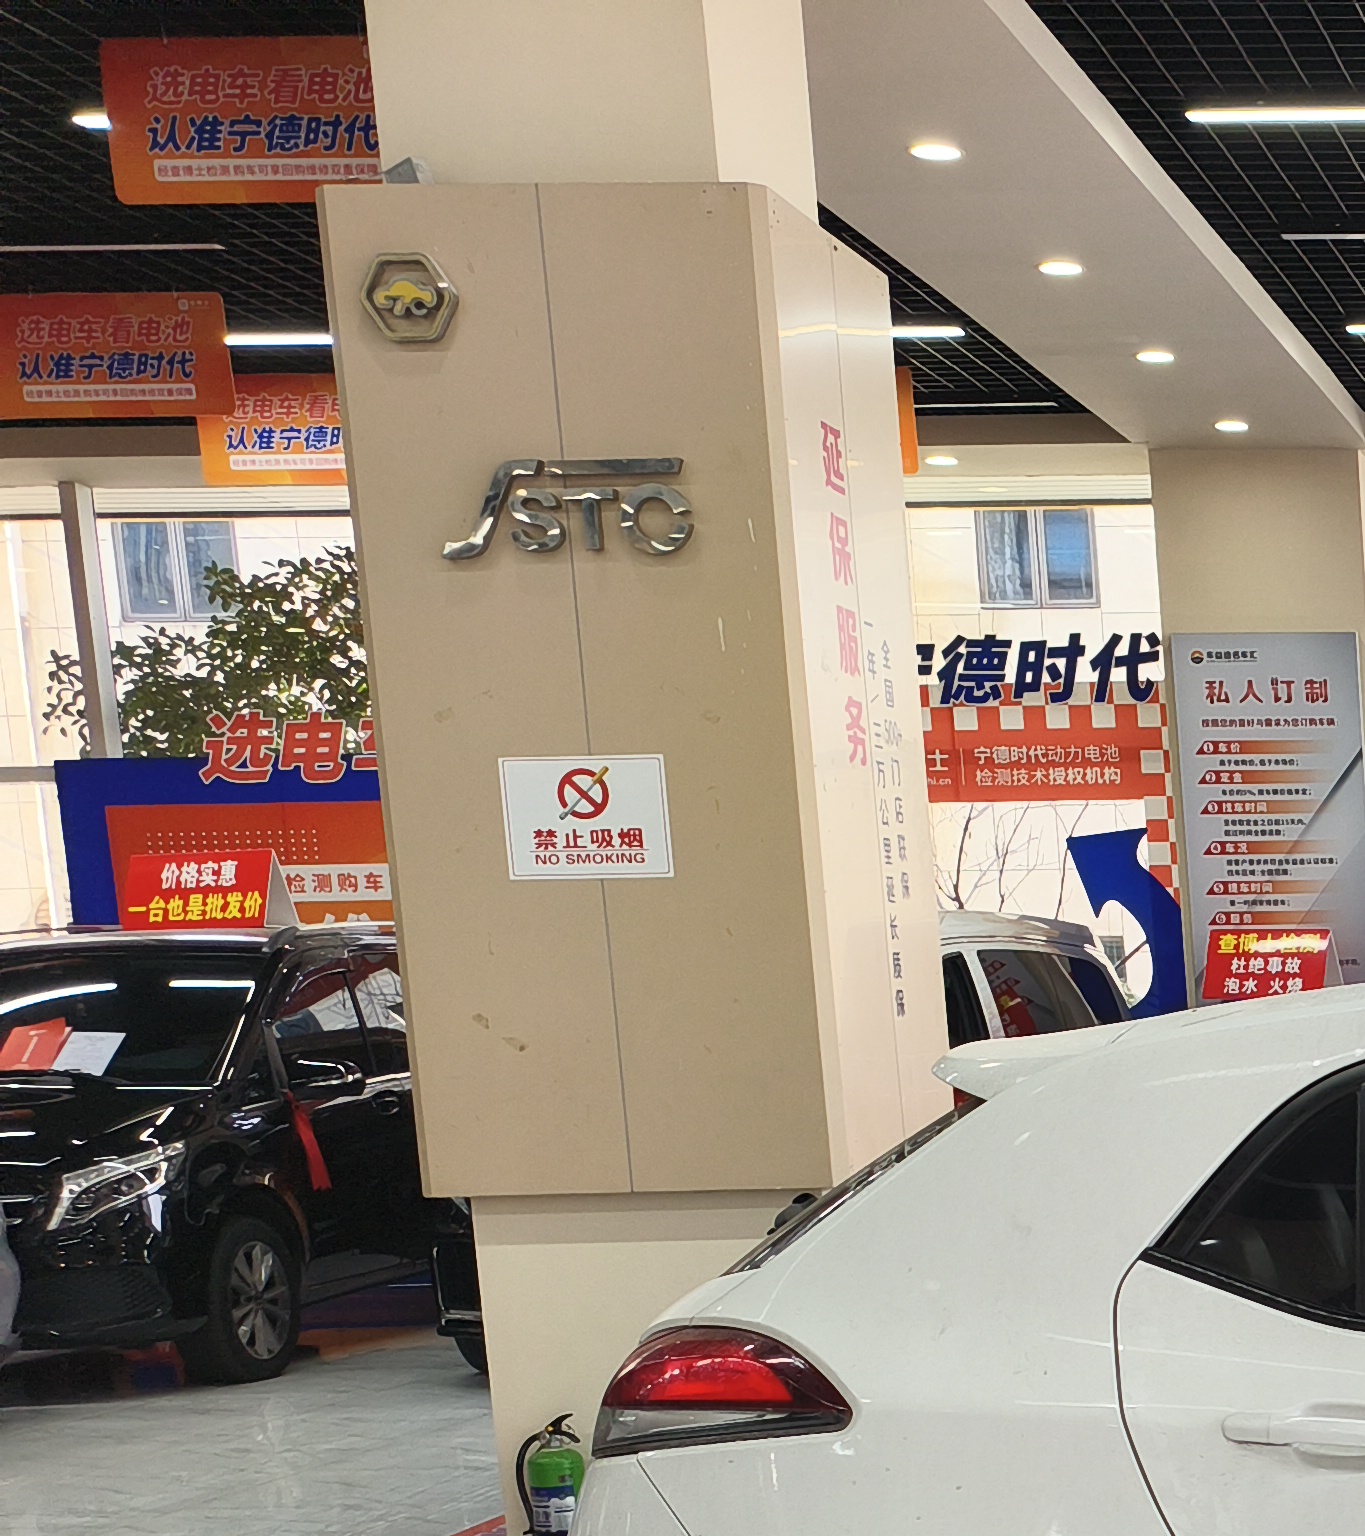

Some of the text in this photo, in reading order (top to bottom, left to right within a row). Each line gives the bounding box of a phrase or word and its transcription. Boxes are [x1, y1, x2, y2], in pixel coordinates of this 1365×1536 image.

[147, 112, 380, 155] 认准宁德时代
[17, 350, 196, 382] 认准宁德时代
[820, 420, 868, 768] 延保服务
[1205, 678, 1329, 704] 私人订制
[927, 749, 949, 771] 士
[974, 744, 1120, 764] 宁德时代动力电池
[975, 766, 1121, 787] 检测技术授权机构
[533, 828, 644, 851] 禁止吸烟
[535, 852, 645, 865] NO SMOKING
[161, 859, 238, 889] 价格实惠
[285, 871, 384, 894] 检测购车
[128, 891, 263, 923] 一台也是批发价
[1231, 956, 1302, 974] 杜绝事故
[1223, 977, 1258, 994] 泡水
